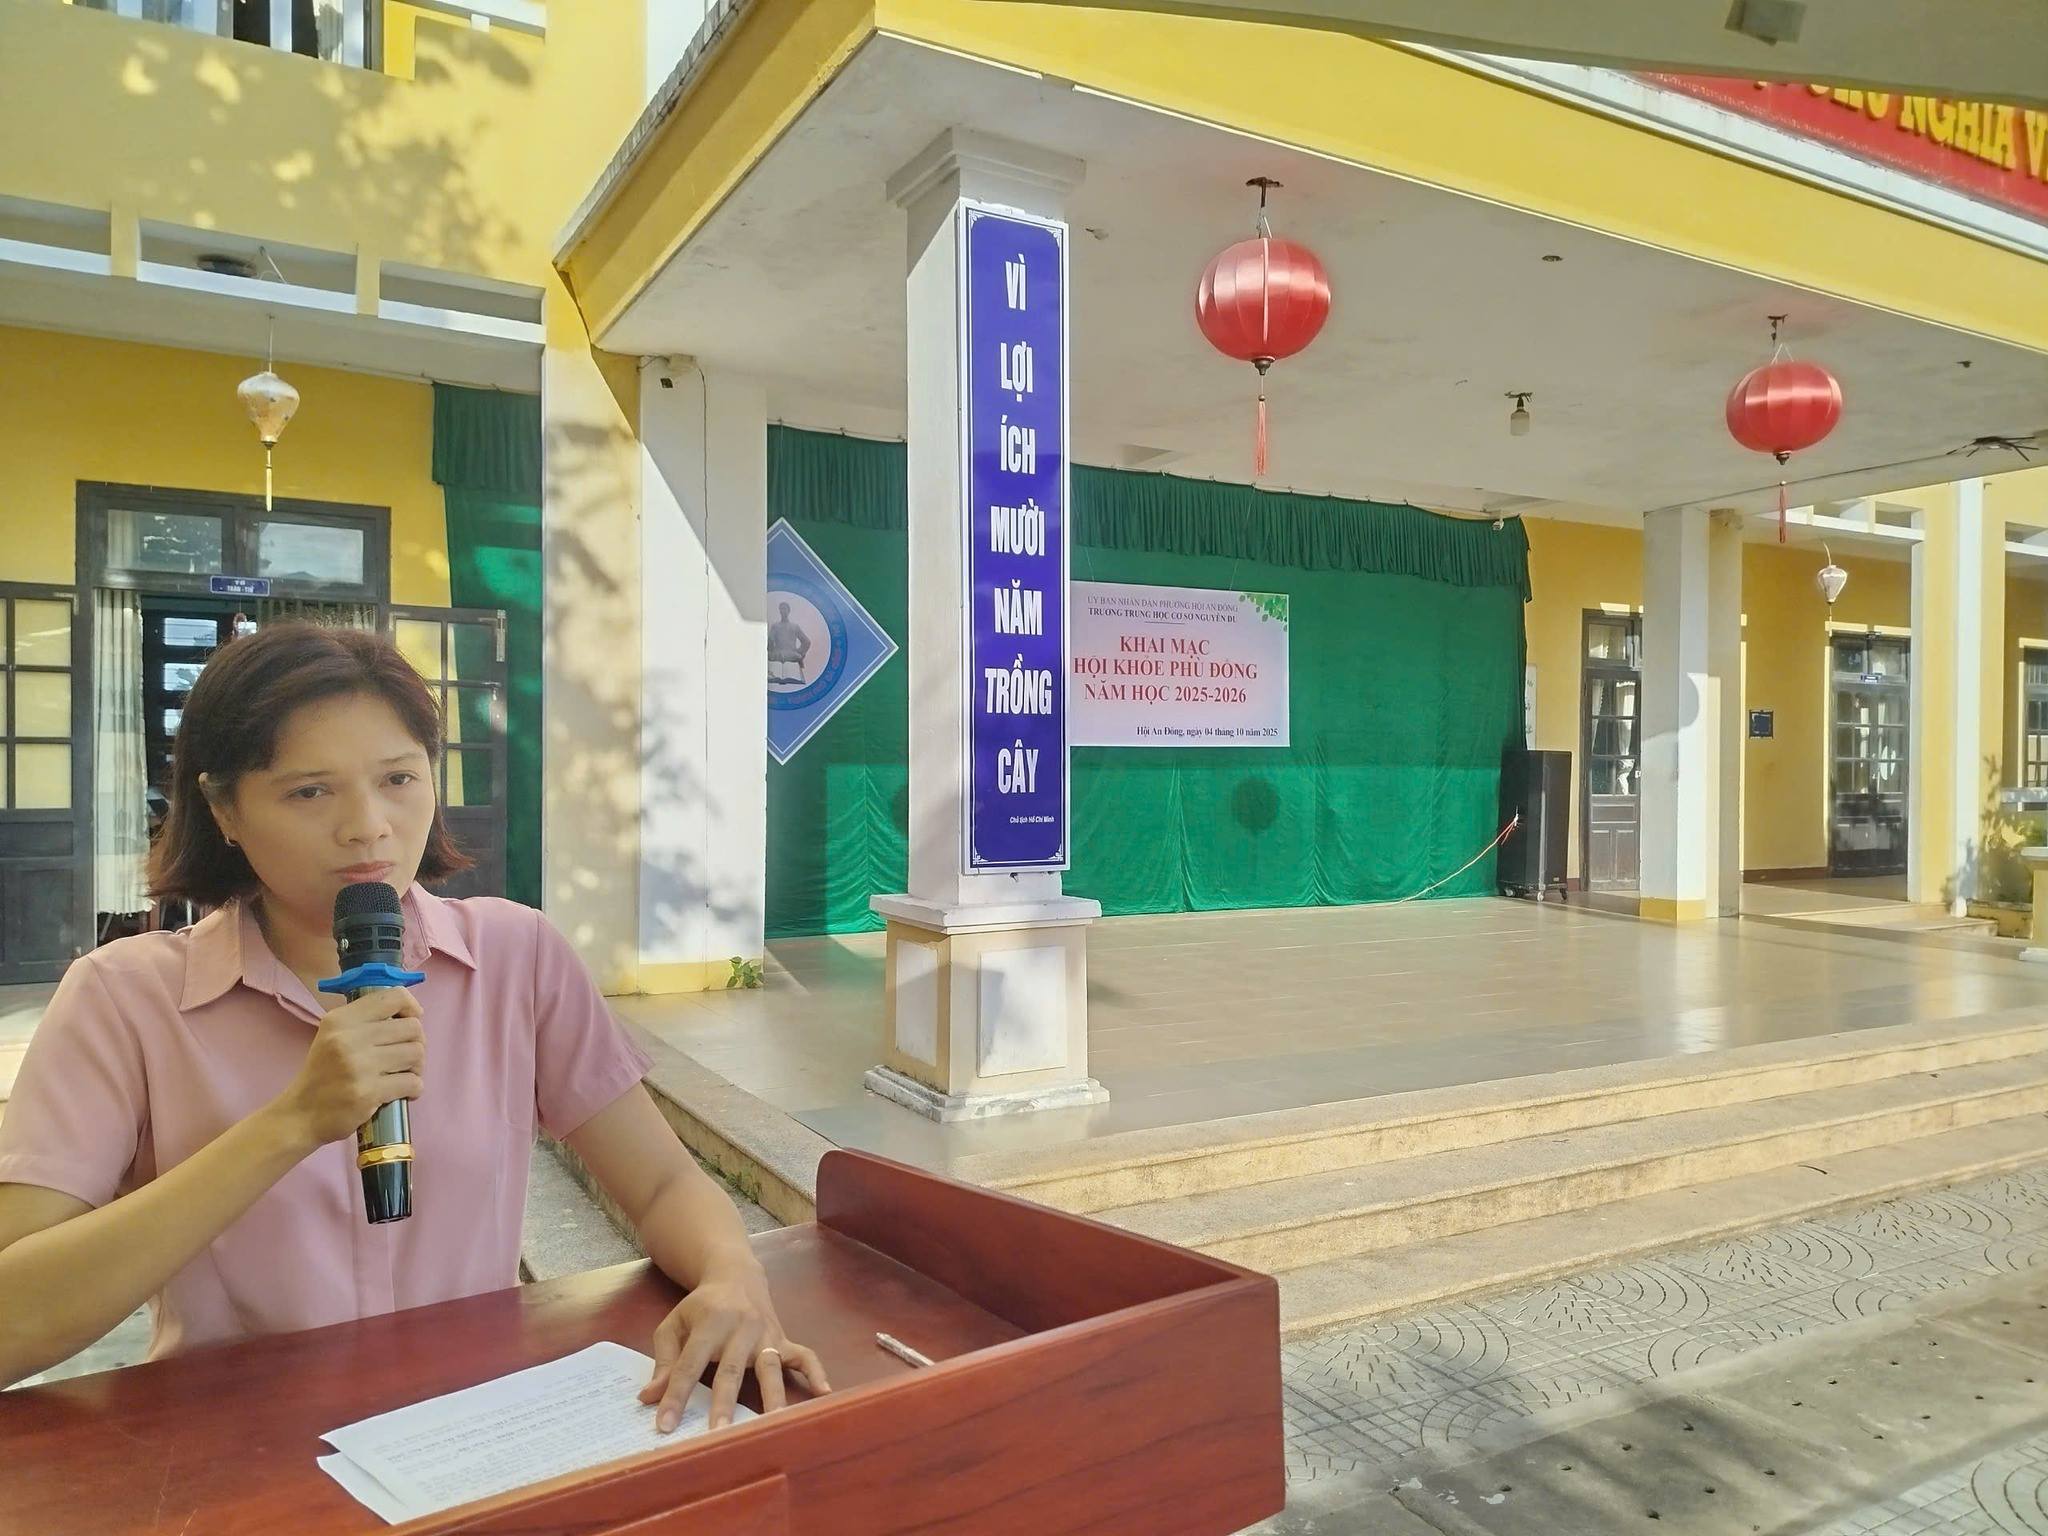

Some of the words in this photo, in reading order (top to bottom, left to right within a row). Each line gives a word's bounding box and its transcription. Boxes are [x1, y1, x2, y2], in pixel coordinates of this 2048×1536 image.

[1005, 253, 1027, 311] VÌ
[1000, 341, 1033, 402] LỢI
[1000, 414, 1036, 475] ÍCH
[990, 497, 1045, 557] MƯỜI
[994, 578, 1043, 636] NĂM
[1124, 609, 1151, 618] TRUNG
[1120, 635, 1164, 653] KHAI
[1171, 638, 1210, 659] MẠC
[1170, 656, 1204, 678] PHÙ
[985, 653, 1052, 715] TRỒNG
[1084, 679, 1125, 700] NĂM
[1132, 684, 1170, 706] HỌC
[1175, 685, 1247, 703] 2025-2026
[1152, 727, 1162, 735] An
[1236, 728, 1244, 736] 10
[1262, 727, 1279, 737] 2025
[997, 739, 1039, 794] CÂY
